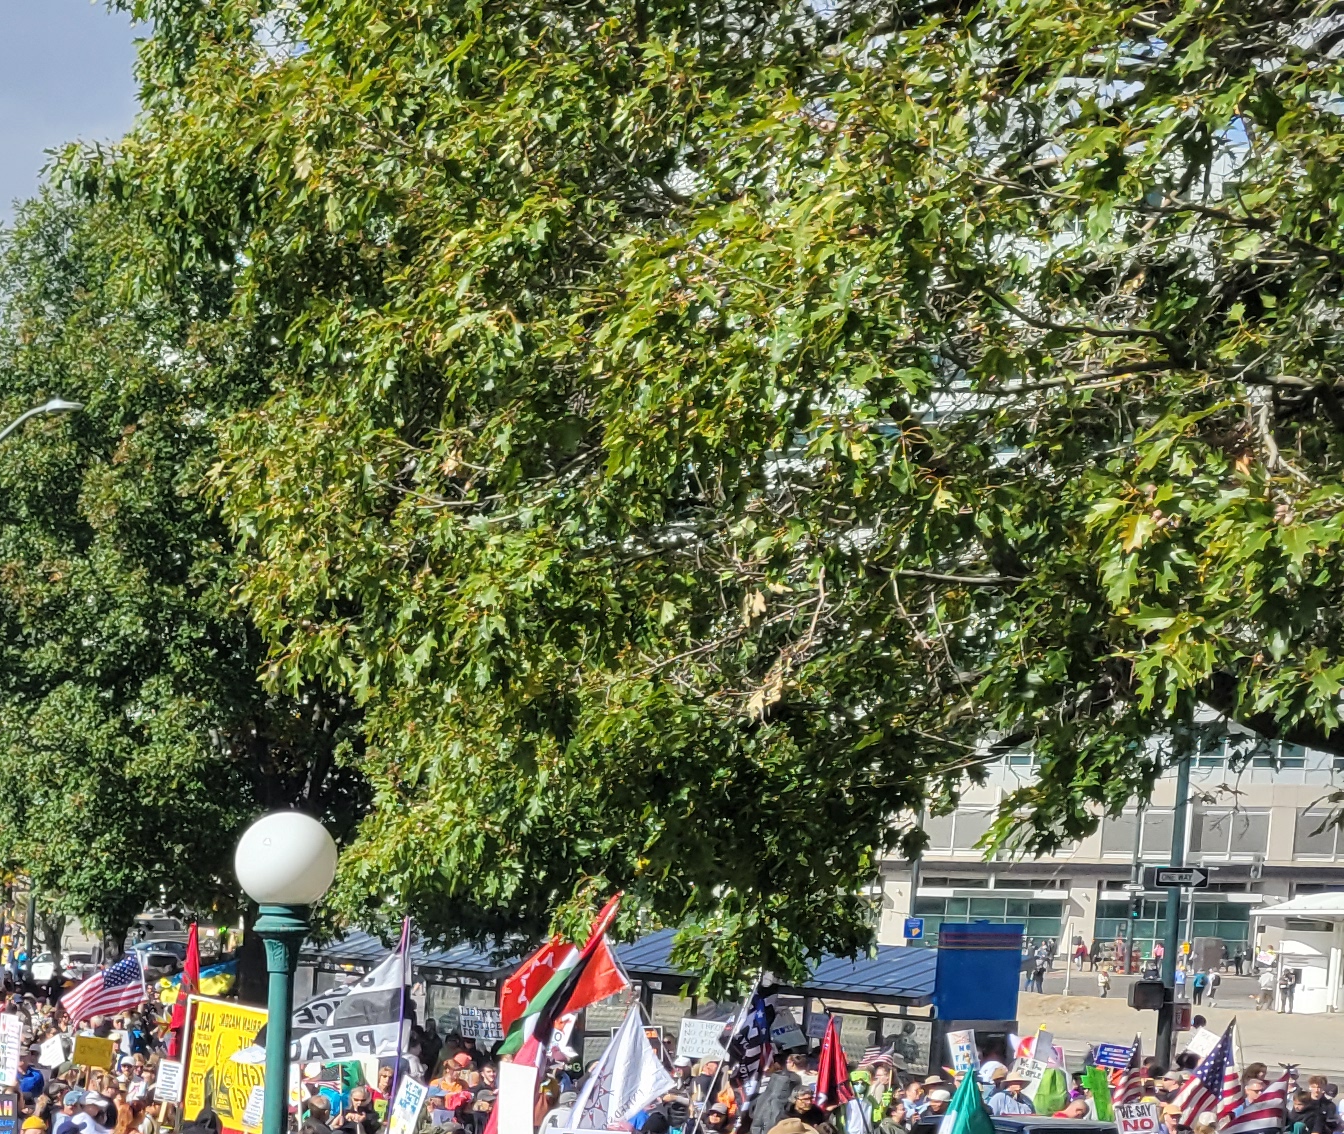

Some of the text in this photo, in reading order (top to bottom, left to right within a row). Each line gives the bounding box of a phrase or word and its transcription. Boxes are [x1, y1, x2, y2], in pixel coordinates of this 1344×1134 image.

[462, 1020, 502, 1030] JUSTICE
[462, 1027, 502, 1039] FOR ALL
[698, 1030, 717, 1038] CRO
[683, 1037, 695, 1045] NO
[1016, 1067, 1041, 1079] PEOPLE
[1119, 1103, 1151, 1118] WE SAY
[1123, 1118, 1154, 1131] NO
